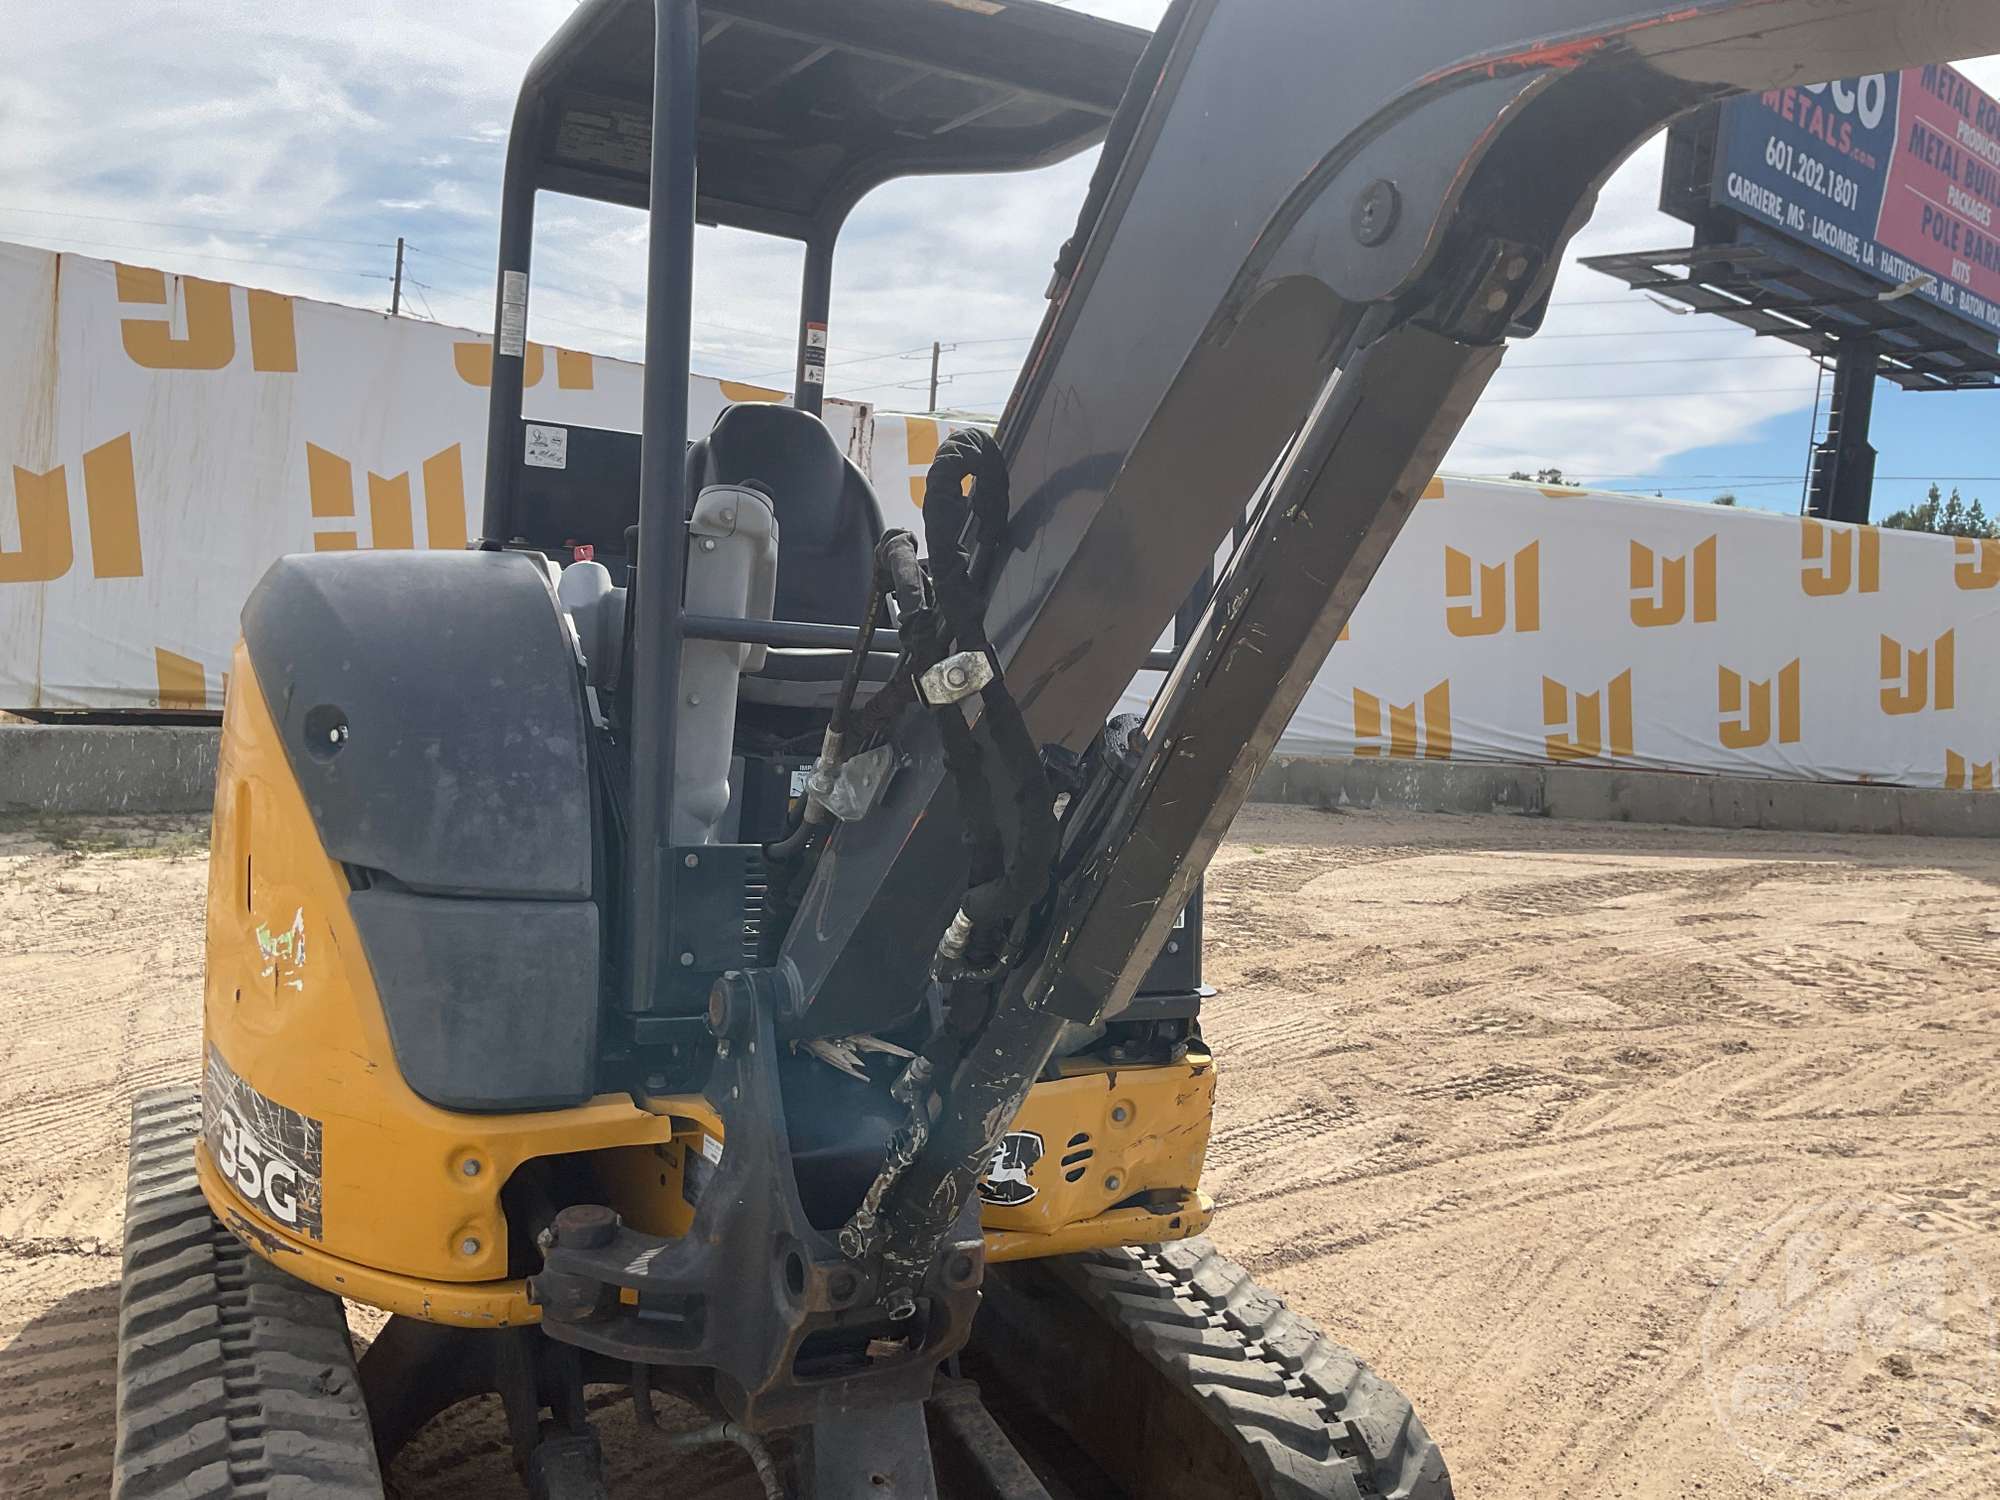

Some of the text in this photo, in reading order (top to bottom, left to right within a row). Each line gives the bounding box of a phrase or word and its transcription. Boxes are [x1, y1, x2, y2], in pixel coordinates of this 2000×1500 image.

[1765, 136, 1859, 211] 601.202.1801
[1908, 123, 1960, 180] METAL
[1727, 172, 1785, 225] CARRIERE,
[1786, 203, 1806, 231] MS
[1812, 216, 1861, 263] LACOMBE,
[1862, 241, 1875, 266] LA
[1941, 282, 1955, 304] MS
[1921, 205, 1960, 252] POLE
[218, 1108, 299, 1223] 35G
